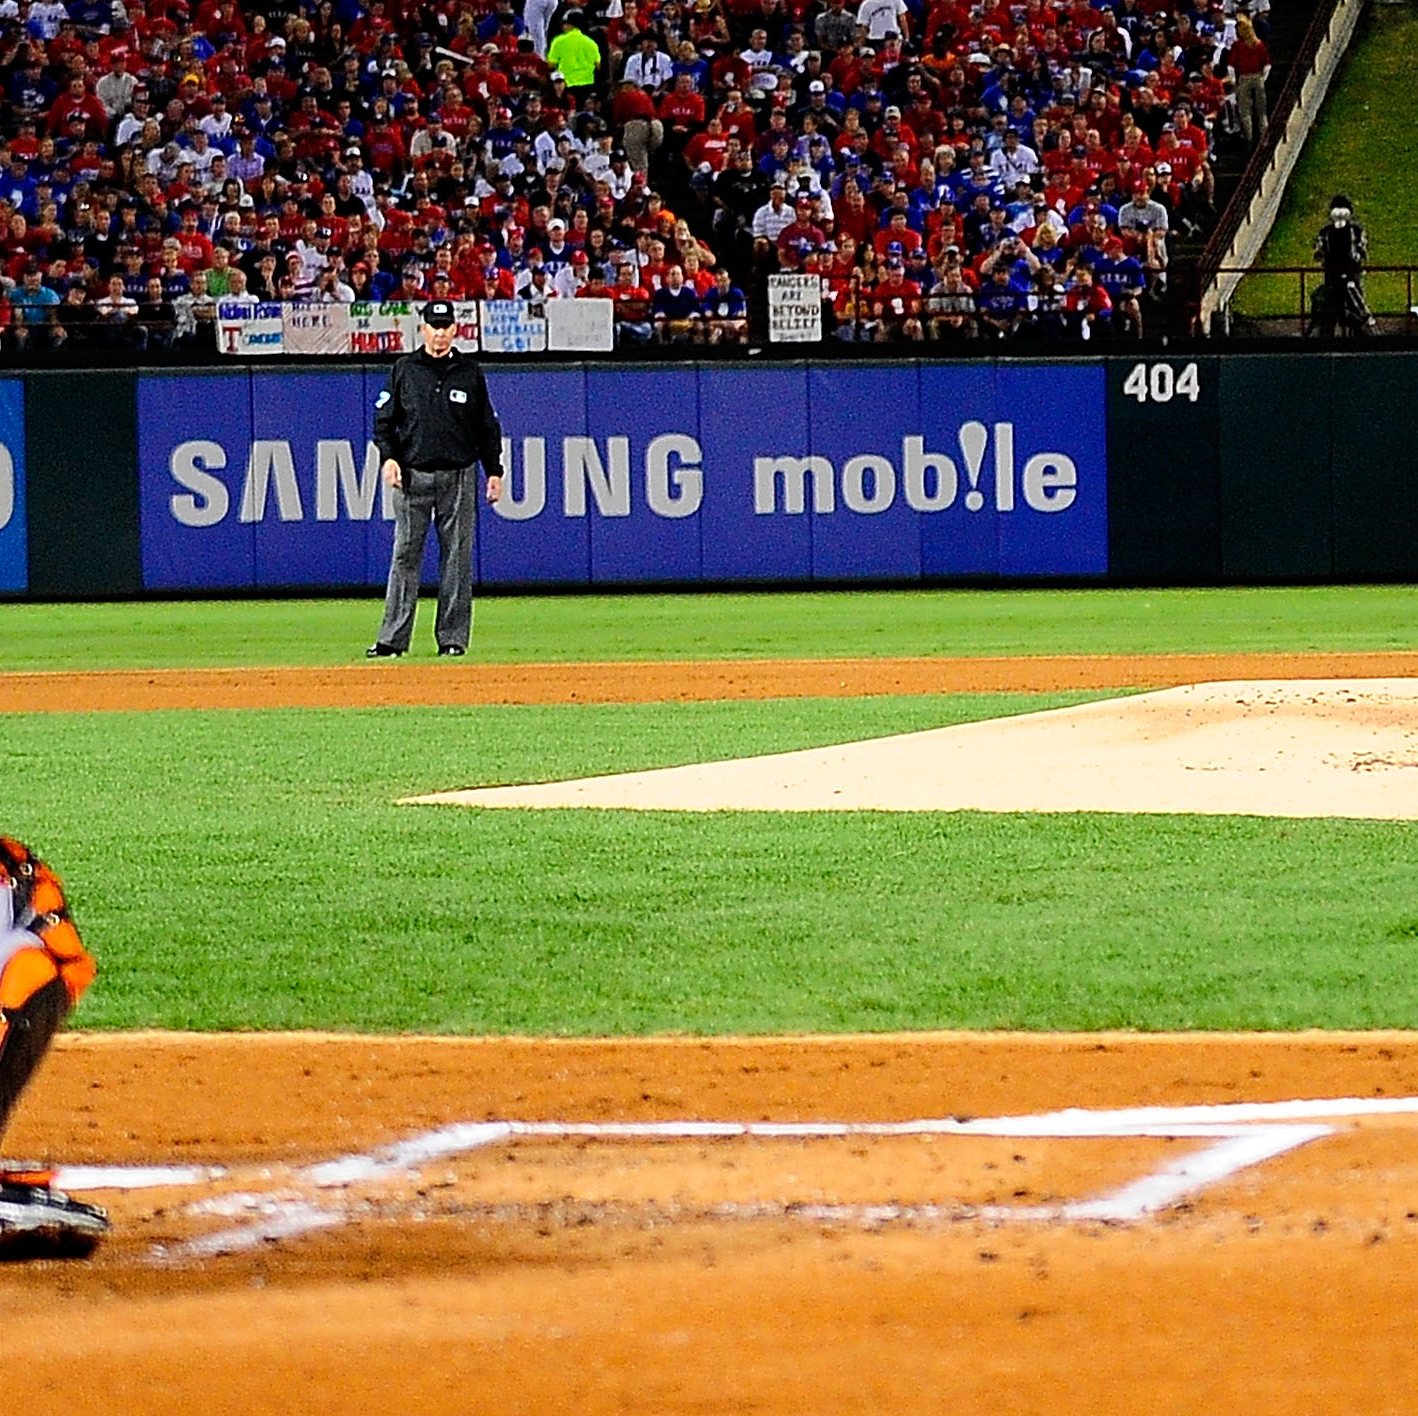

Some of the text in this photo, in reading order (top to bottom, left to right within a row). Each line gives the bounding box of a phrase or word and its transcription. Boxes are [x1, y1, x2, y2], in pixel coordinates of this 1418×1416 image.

[773, 304, 820, 316] BEYOND
[772, 318, 818, 330] BELIEF
[1123, 362, 1201, 403] 404
[169, 432, 704, 527] SAMUNG
